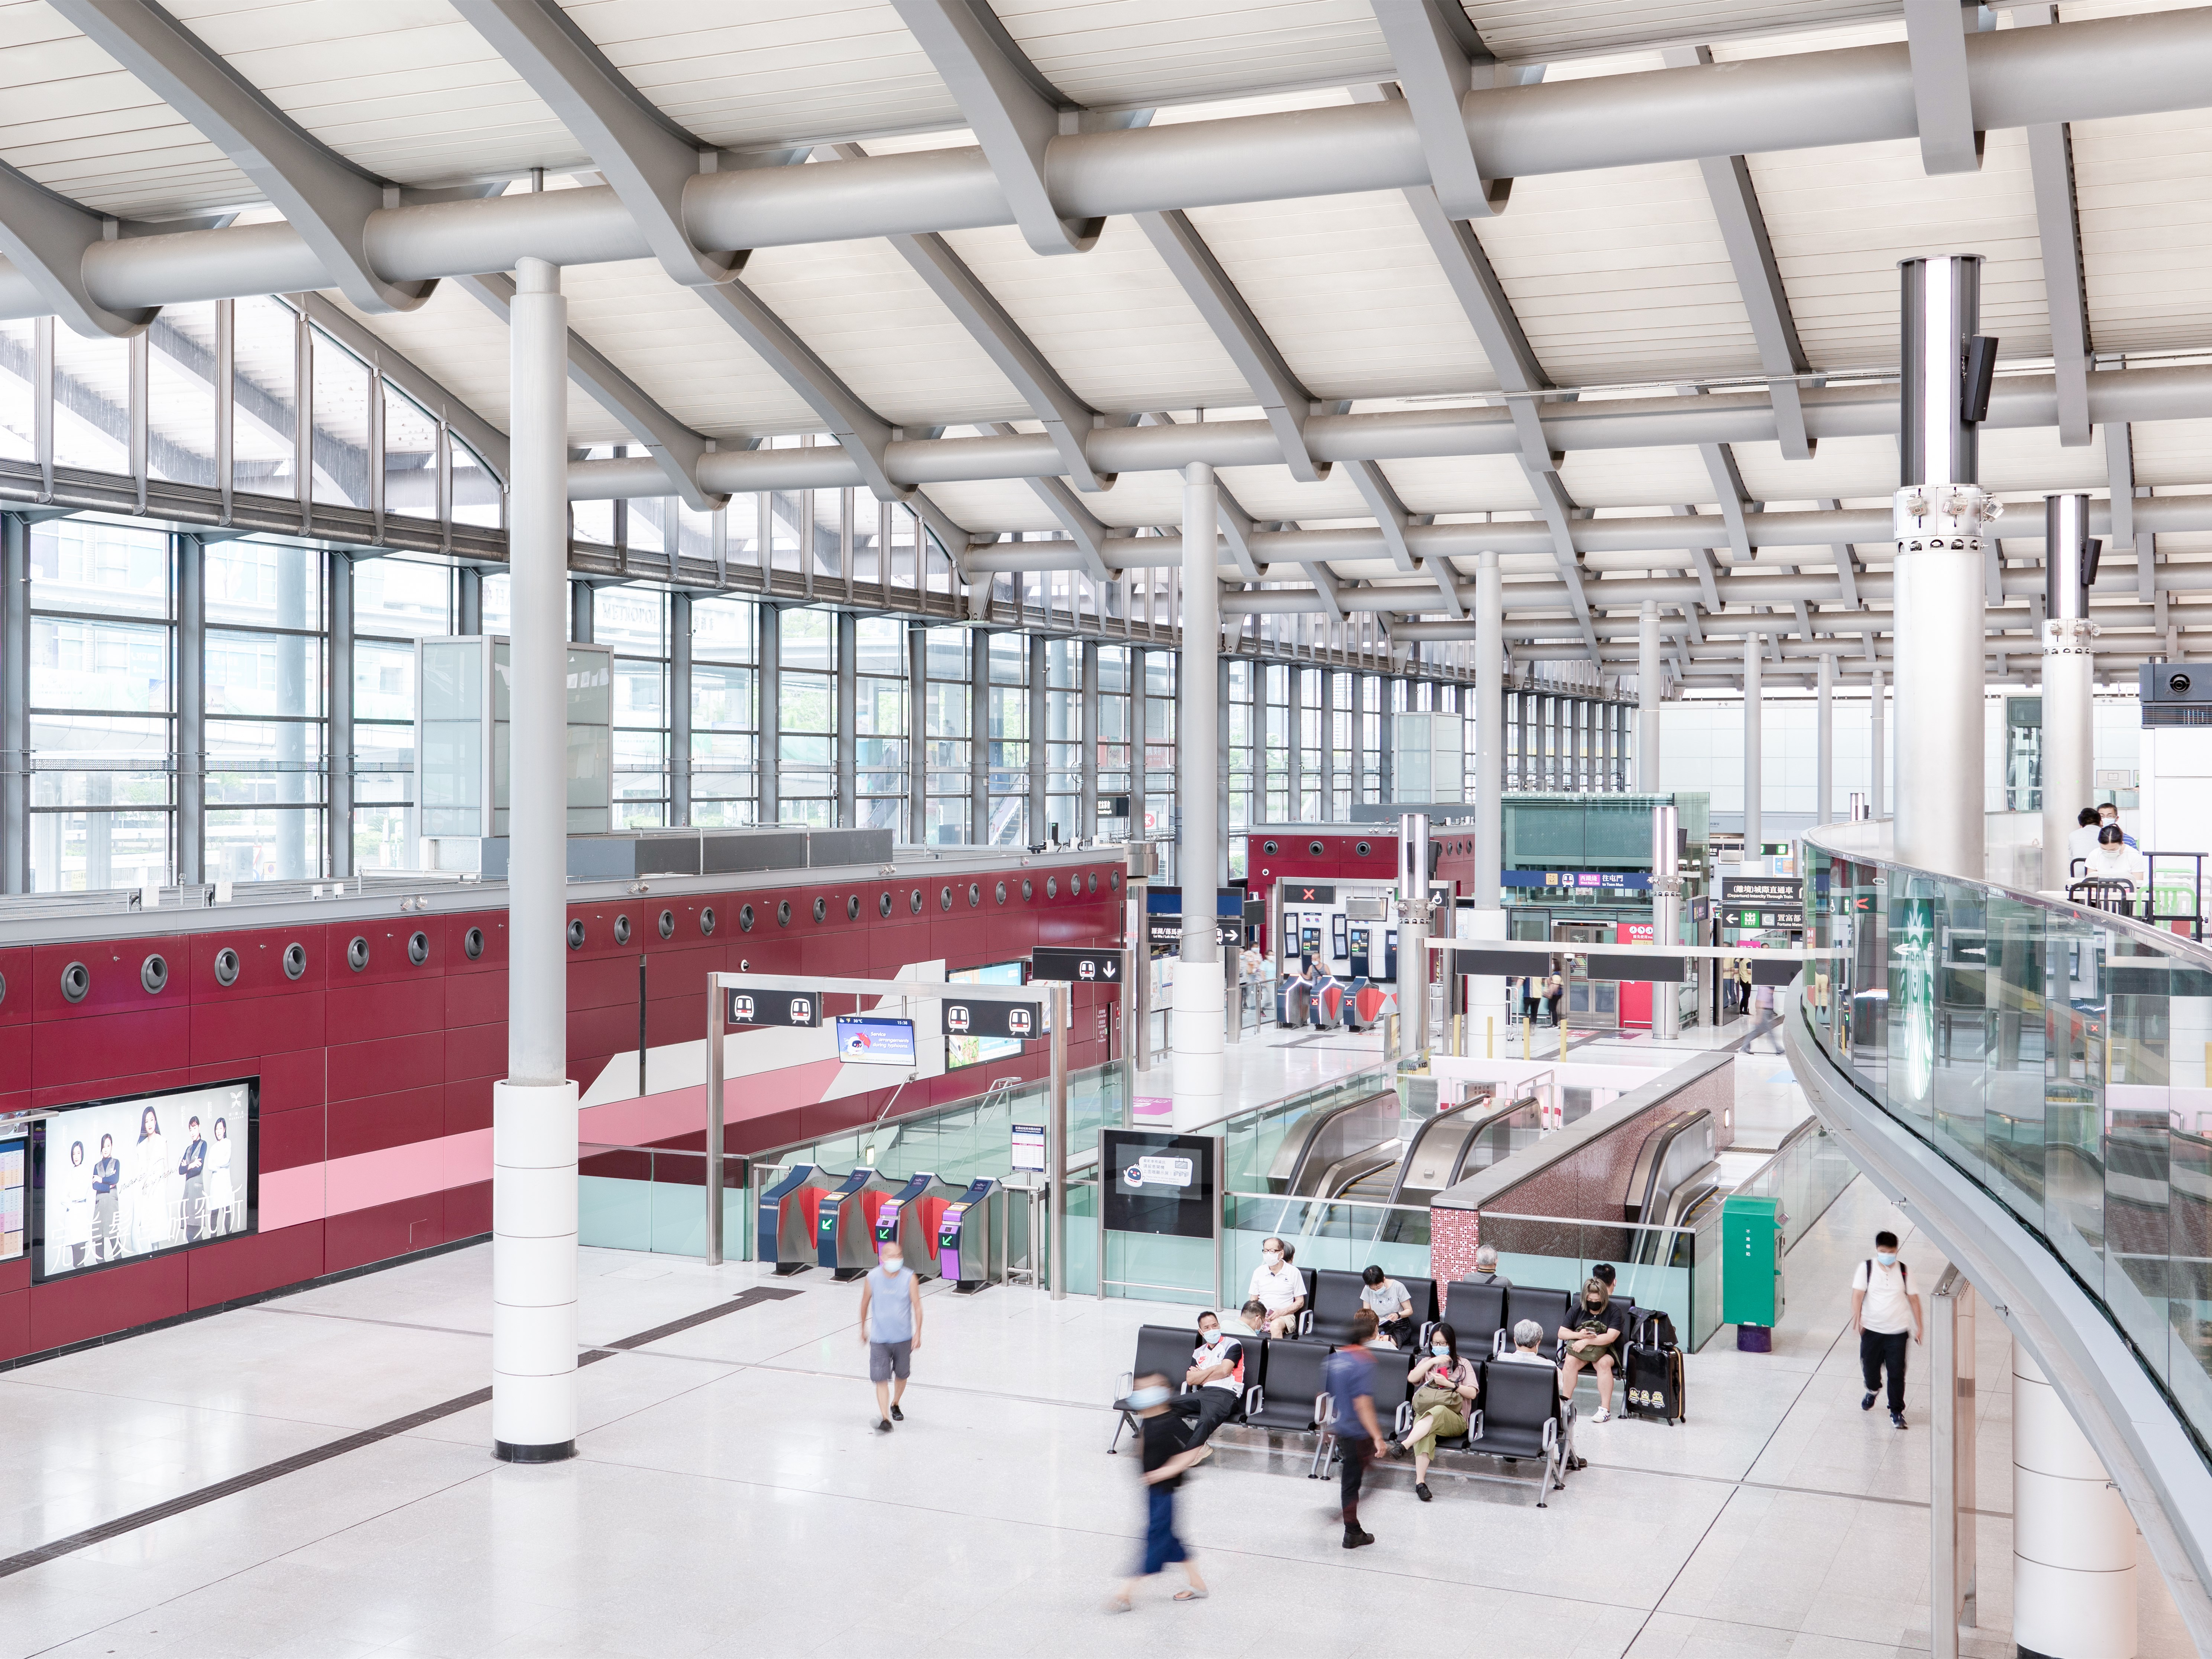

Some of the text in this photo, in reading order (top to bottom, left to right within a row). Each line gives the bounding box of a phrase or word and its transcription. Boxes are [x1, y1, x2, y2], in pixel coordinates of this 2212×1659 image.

[1733, 885, 1793, 894] (離境)城際直通車
[1744, 913, 1756, 922] 出
